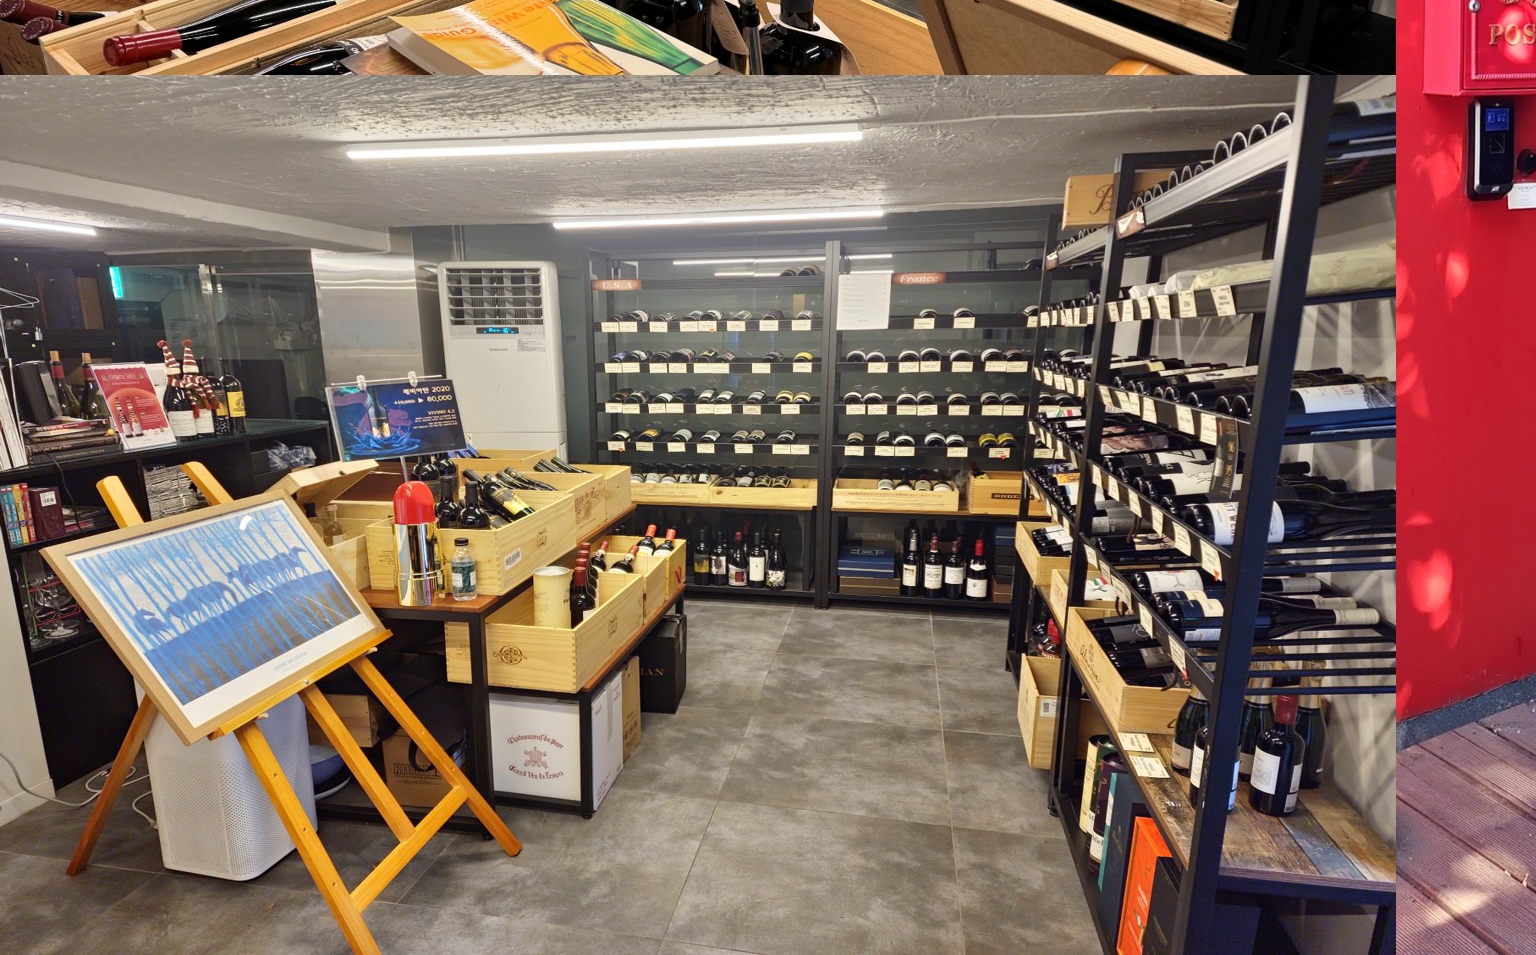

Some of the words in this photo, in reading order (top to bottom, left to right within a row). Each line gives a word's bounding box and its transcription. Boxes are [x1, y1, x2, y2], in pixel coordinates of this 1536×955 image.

[900, 274, 941, 284] France
[431, 385, 450, 393] 2020
[427, 394, 453, 404] 80,000
